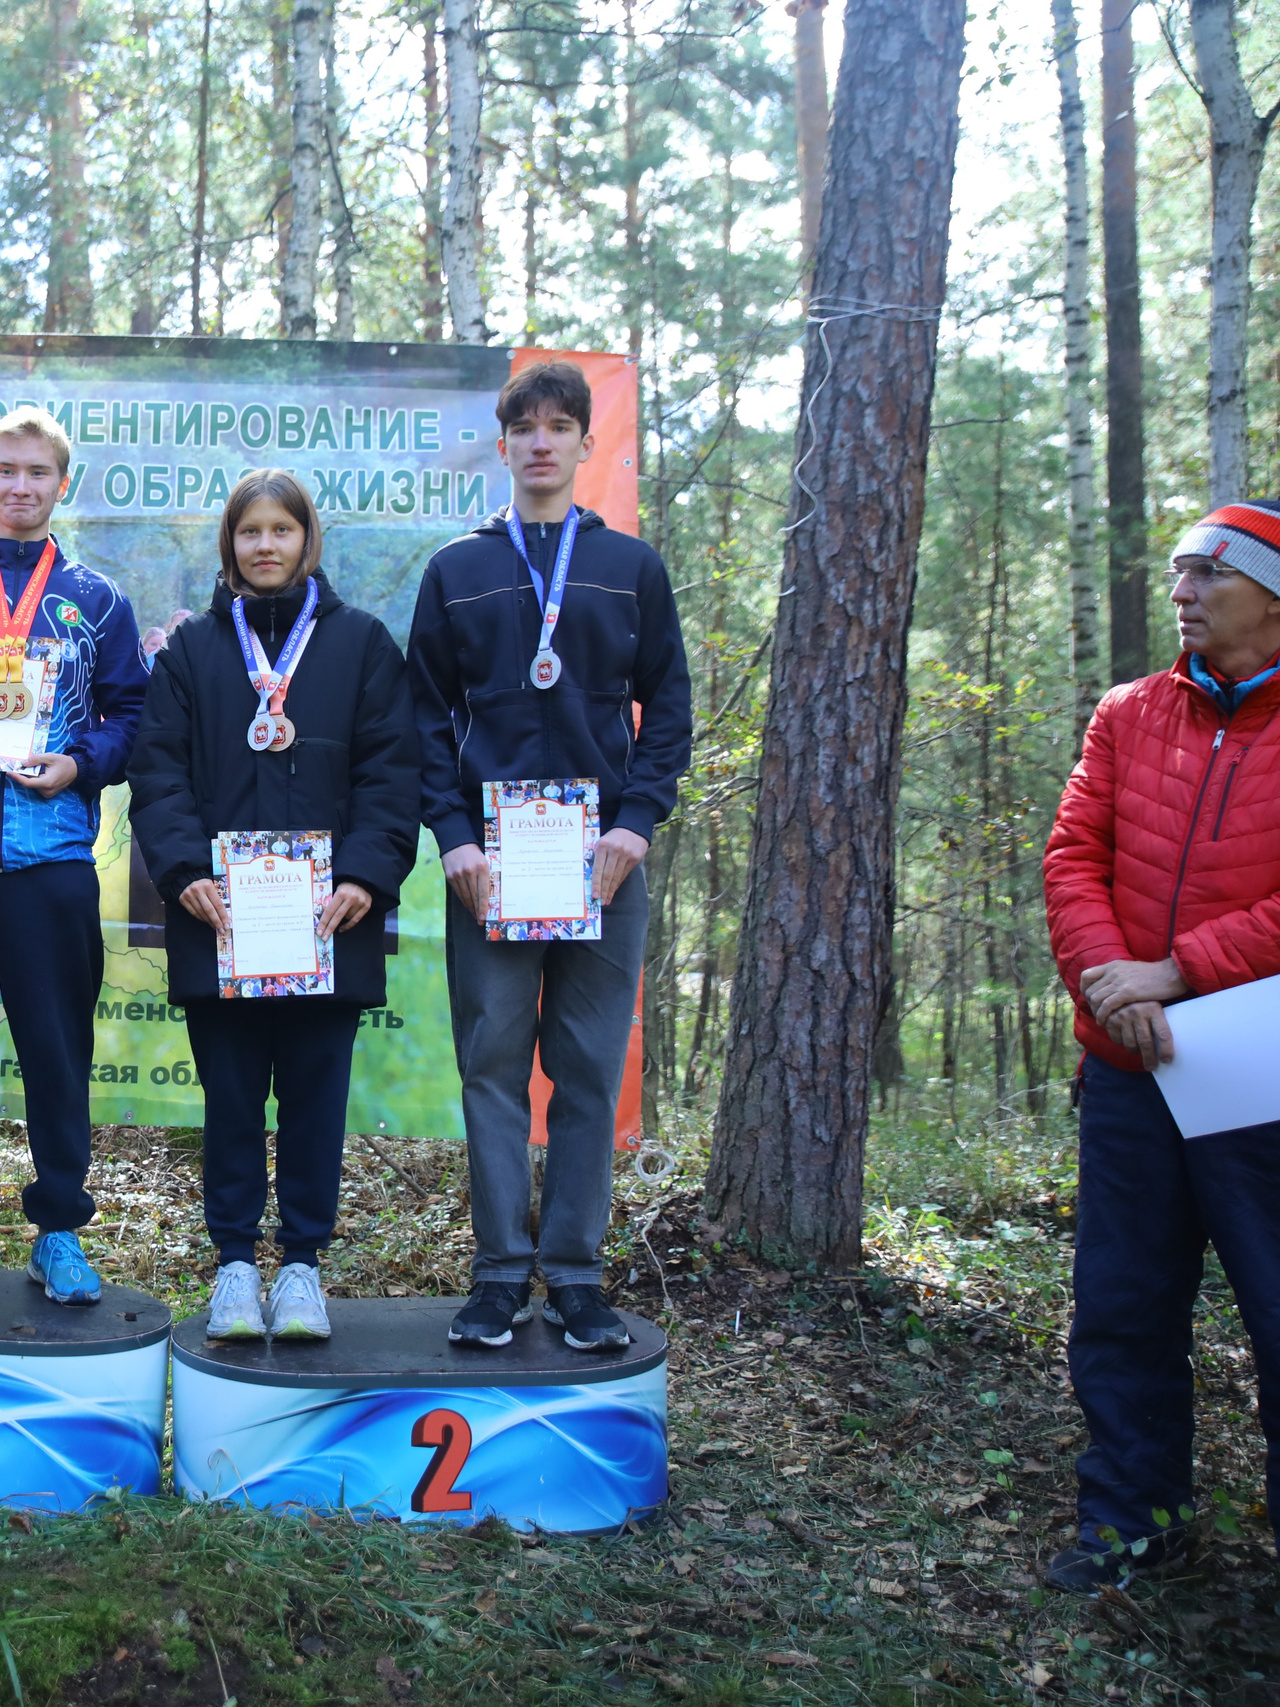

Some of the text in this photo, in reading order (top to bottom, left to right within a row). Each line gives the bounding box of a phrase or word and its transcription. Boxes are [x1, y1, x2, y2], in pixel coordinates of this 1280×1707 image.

[104, 464, 297, 511] ОБРА
[312, 467, 487, 517] ЖИЗНИ
[13, 595, 30, 625] ОБЛАСТЬ
[234, 607, 252, 659] ЧЕЛЯБИНСКАЯ
[282, 628, 300, 662] ОБЛАСТЬ
[508, 816, 574, 829] ГРАМОТА
[238, 872, 303, 886] ГРАМОТА
[409, 1407, 474, 1513] 2
